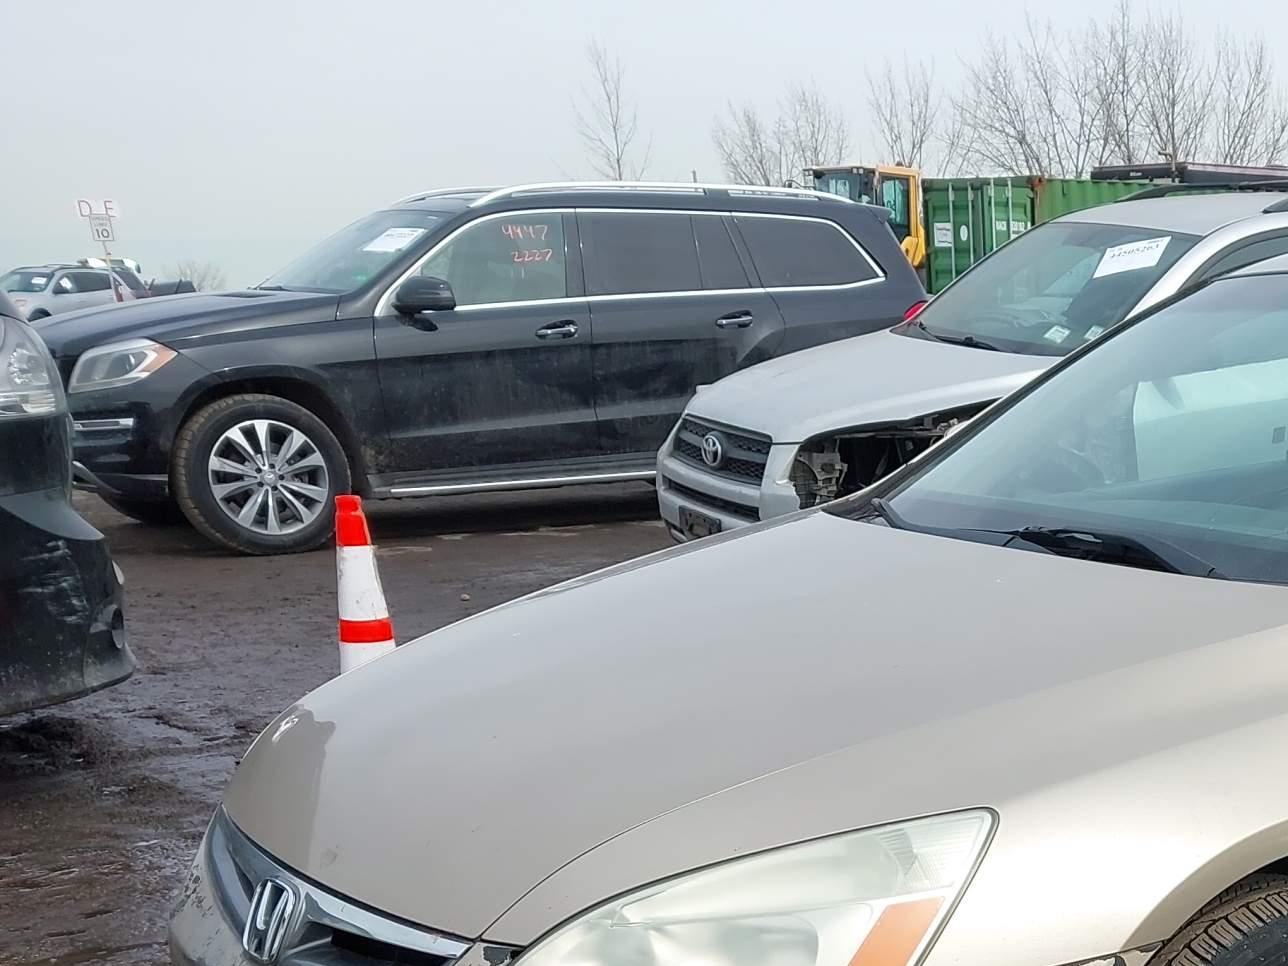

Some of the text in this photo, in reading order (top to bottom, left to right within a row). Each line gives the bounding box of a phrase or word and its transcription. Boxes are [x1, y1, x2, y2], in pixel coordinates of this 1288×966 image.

[78, 200, 117, 217] D E
[95, 228, 110, 239] 10
[511, 248, 553, 262] 2227
